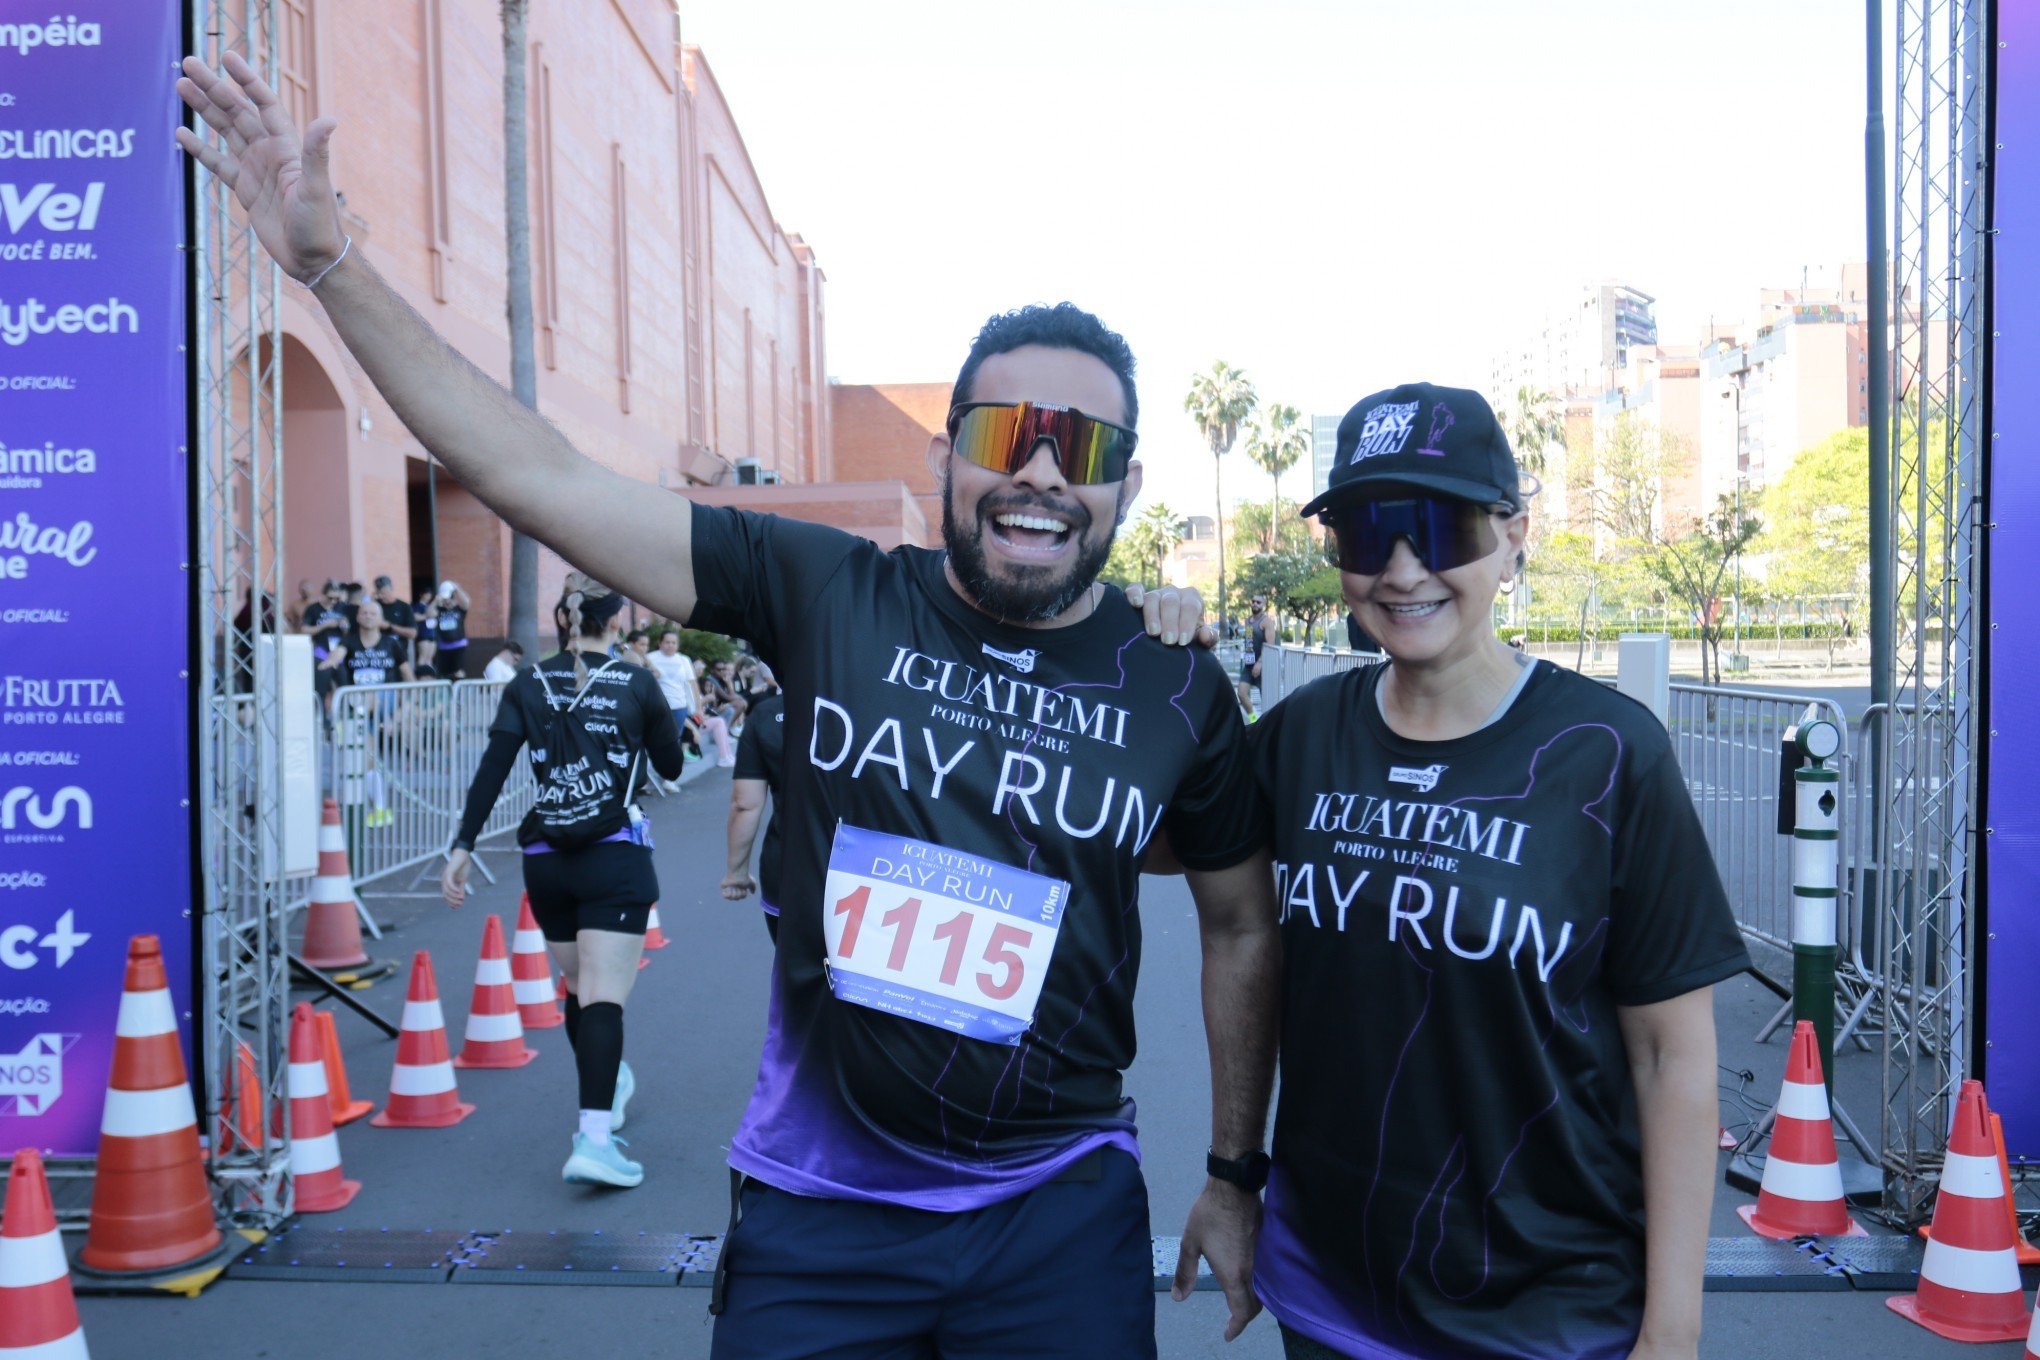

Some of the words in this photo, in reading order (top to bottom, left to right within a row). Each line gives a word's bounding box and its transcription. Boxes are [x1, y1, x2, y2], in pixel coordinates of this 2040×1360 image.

[0, 181, 106, 235] Vel
[49, 242, 98, 260] BEM.
[0, 297, 139, 346] ytech
[10, 375, 77, 390] OFICIAL:
[1361, 411, 1417, 438] DAY
[1350, 425, 1414, 465] RUN
[3, 608, 70, 623] OFICIAL:
[0, 675, 125, 707] FRUTTA
[882, 646, 1131, 748] IGUATEMI
[4, 711, 59, 725] PORTO
[63, 711, 125, 724] ALEGRE
[930, 704, 992, 732] PORTO
[997, 721, 1071, 754] ALEGRE
[13, 751, 80, 766] OFICIAL:
[809, 696, 976, 799] DAY
[992, 749, 1164, 857] RUN
[567, 769, 613, 801] RUN
[1407, 772, 1435, 783] SINOS
[0, 785, 93, 829] run
[1304, 792, 1532, 865] IGUATEMI
[902, 843, 993, 878] IGUATEMI
[1333, 840, 1386, 860] PORTO
[1391, 848, 1460, 873] ALEGRE
[871, 857, 937, 887] DAY
[942, 873, 1014, 911] RUN
[1040, 885, 1061, 921] 10km
[834, 885, 1033, 1001] 1115
[1388, 875, 1573, 983] RUN
